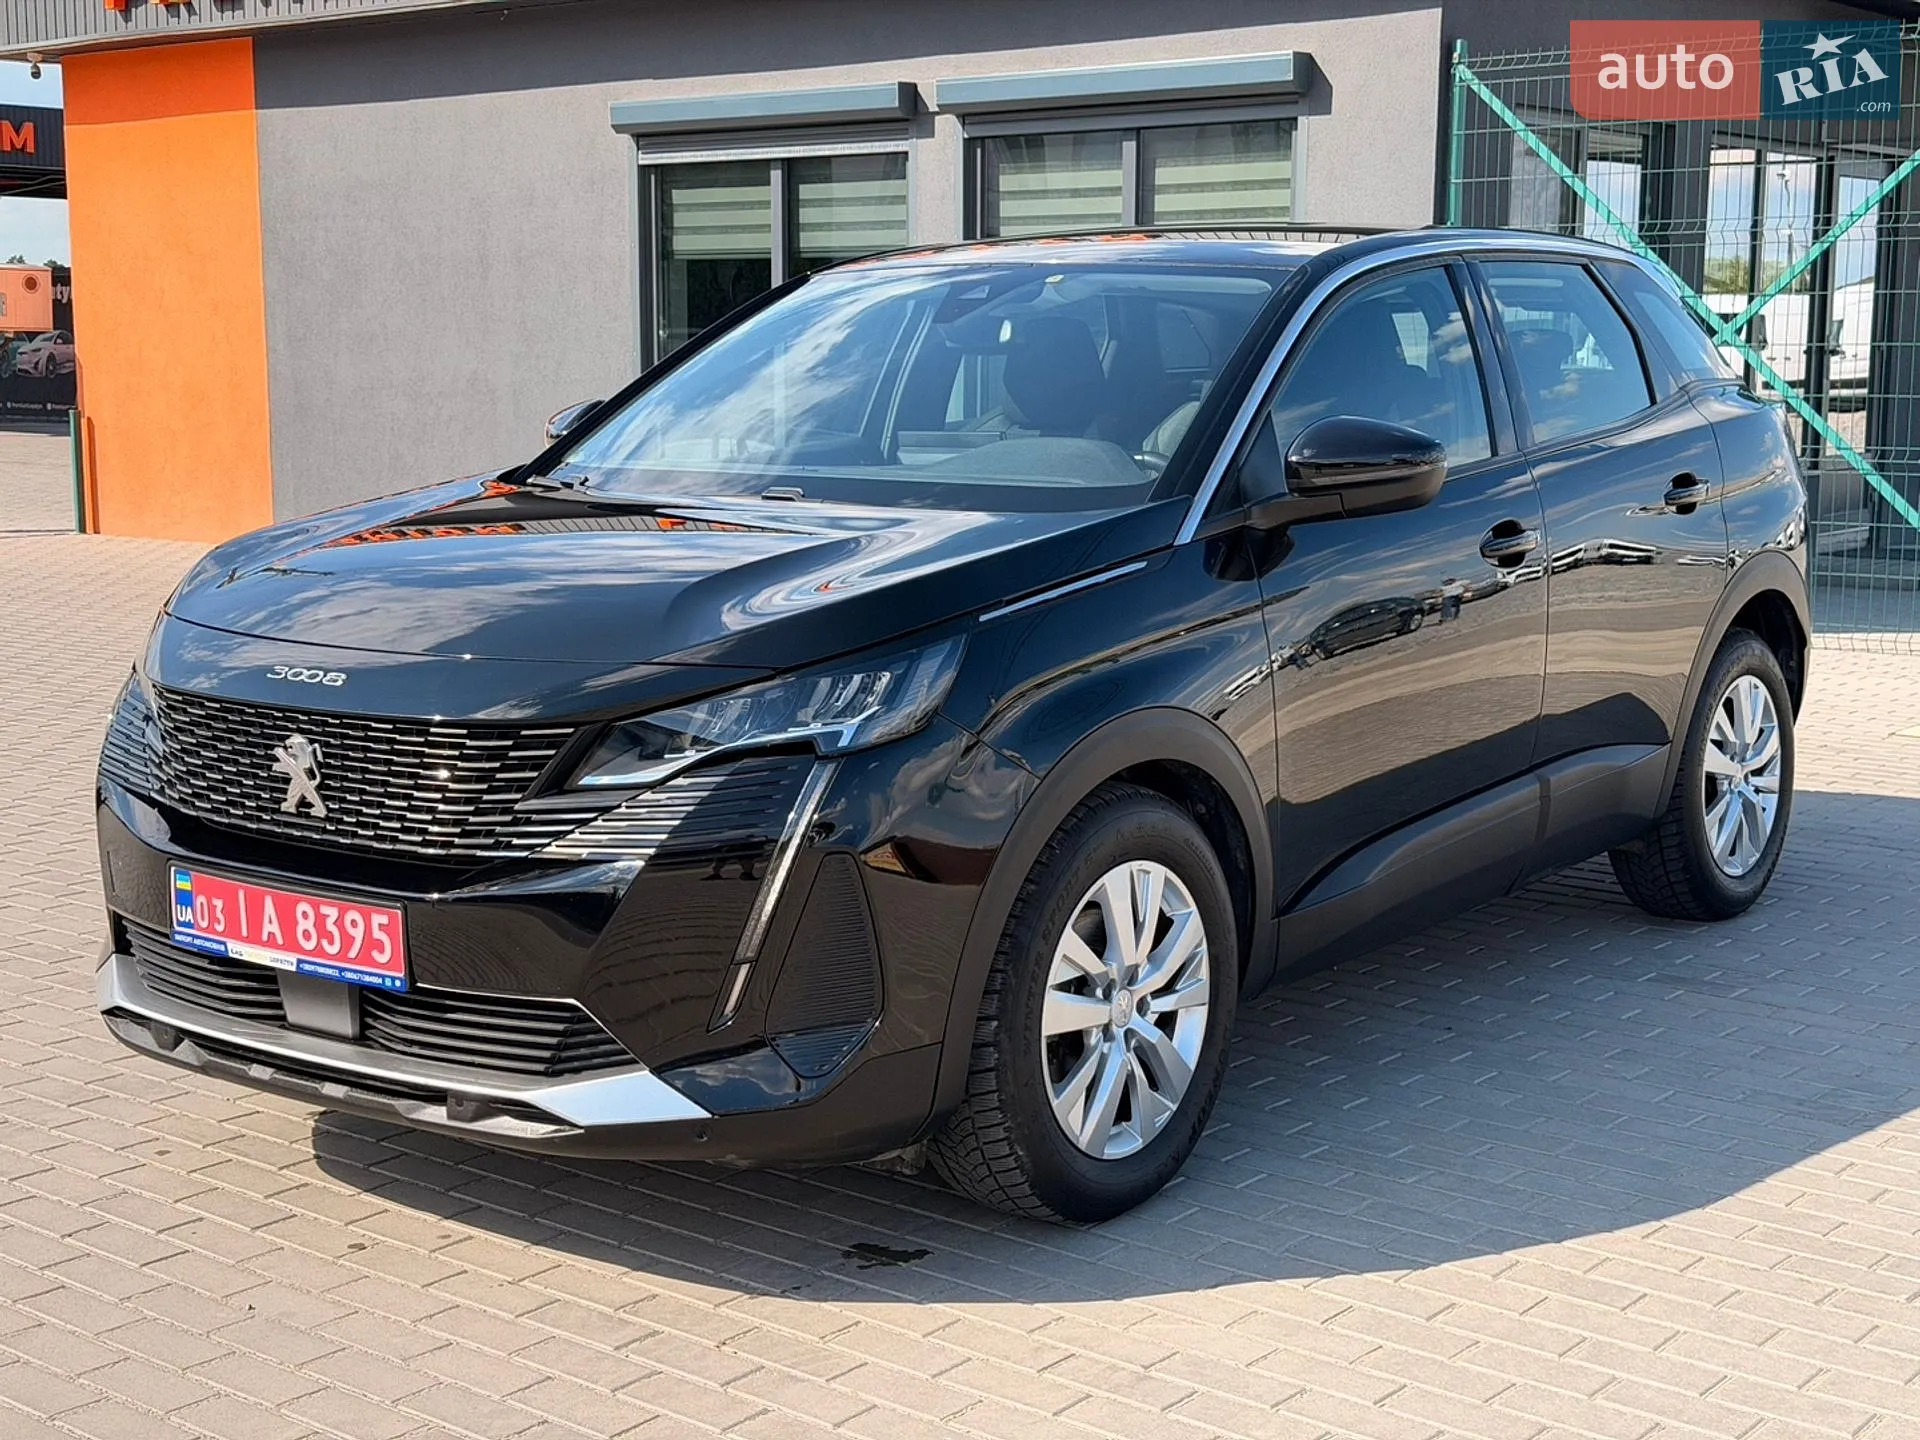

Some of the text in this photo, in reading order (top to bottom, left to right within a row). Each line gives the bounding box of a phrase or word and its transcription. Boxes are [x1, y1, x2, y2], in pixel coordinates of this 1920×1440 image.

[266, 665, 347, 686] 3008
[177, 904, 194, 923] UA
[196, 889, 393, 964] 03 IA 8395
